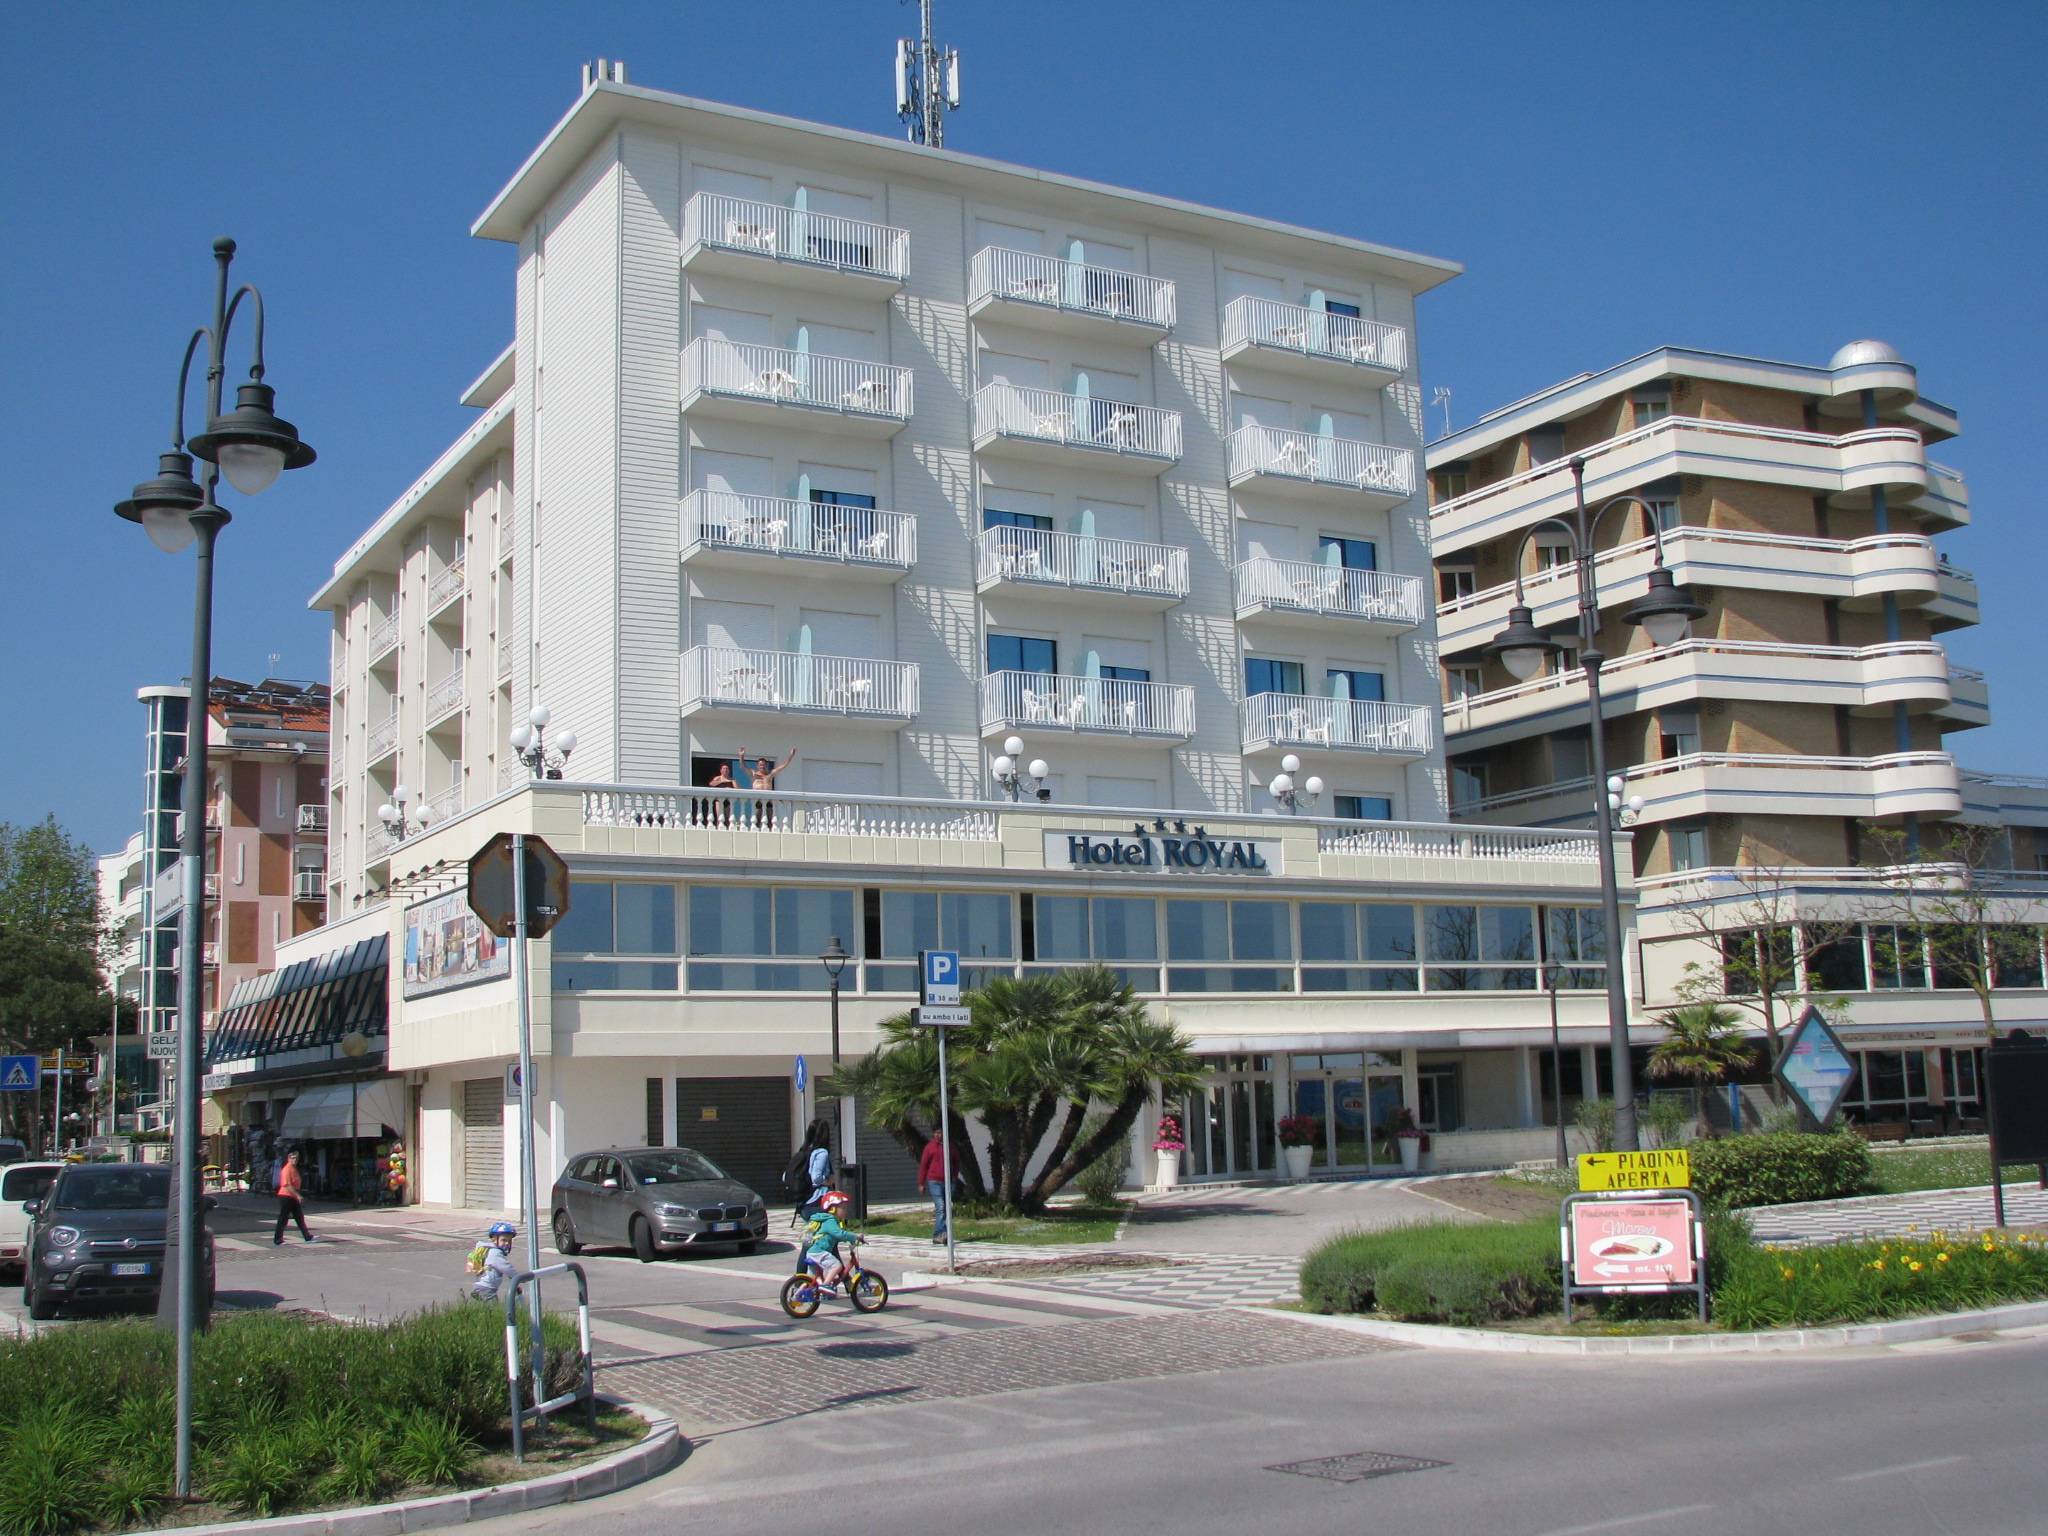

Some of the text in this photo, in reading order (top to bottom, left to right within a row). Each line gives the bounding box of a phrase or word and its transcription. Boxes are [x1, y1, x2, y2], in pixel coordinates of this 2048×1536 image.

[1067, 835, 1267, 869] Hotel ROYAL
[933, 956, 951, 982] P
[1618, 1151, 1685, 1169] PIADINA
[1607, 1171, 1671, 1189] APERTA
